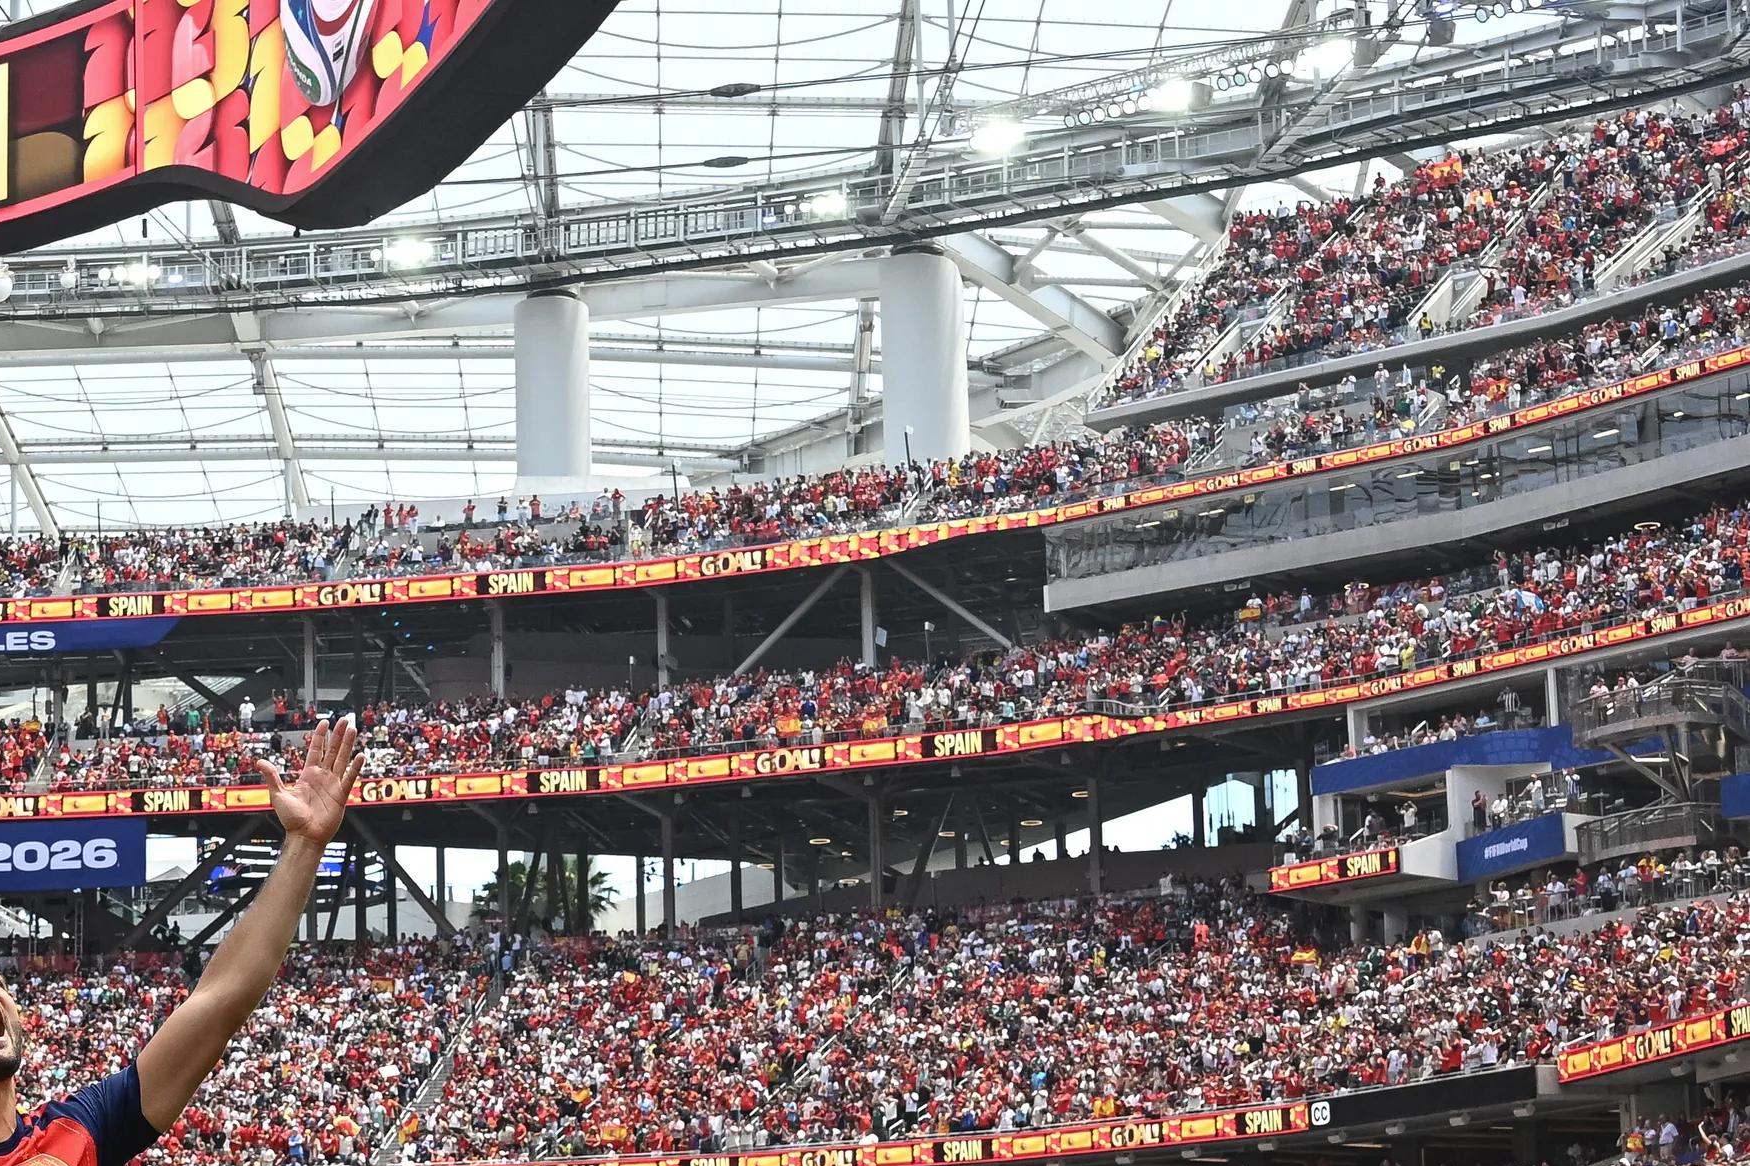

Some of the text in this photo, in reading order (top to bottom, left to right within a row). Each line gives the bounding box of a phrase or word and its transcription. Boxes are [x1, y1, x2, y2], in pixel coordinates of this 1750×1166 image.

[1676, 362, 1700, 380] SPAIN
[1591, 384, 1622, 405] GOAL!
[1489, 413, 1511, 432] SPAIN
[1403, 435, 1437, 454] GOAL!
[1292, 458, 1316, 475] SPAIN
[1207, 474, 1238, 491] GOAL!
[1103, 495, 1126, 511] SPAIN
[701, 550, 761, 575] GOAL!
[488, 572, 534, 593] SPAIN
[319, 583, 380, 605] GOAL!
[109, 596, 153, 616] SPAIN
[1651, 615, 1676, 632] SPAIN
[1560, 634, 1593, 652] GOAL!
[1453, 660, 1476, 676] SPAIN
[1371, 677, 1403, 694] GOAL!
[1257, 697, 1281, 713] SPAIN
[934, 731, 982, 757] SPAIN
[756, 748, 820, 774] GOAL!
[362, 779, 426, 802] GOAL!
[539, 769, 586, 792] SPAIN
[143, 790, 189, 812] SPAIN
[1346, 852, 1381, 877] SPAIN
[1636, 1029, 1670, 1059] GOAL!
[1245, 1109, 1282, 1134] SPAIN
[1314, 1105, 1328, 1121] CC
[1111, 1124, 1160, 1146] GOAL!
[943, 1140, 982, 1162] SPAIN
